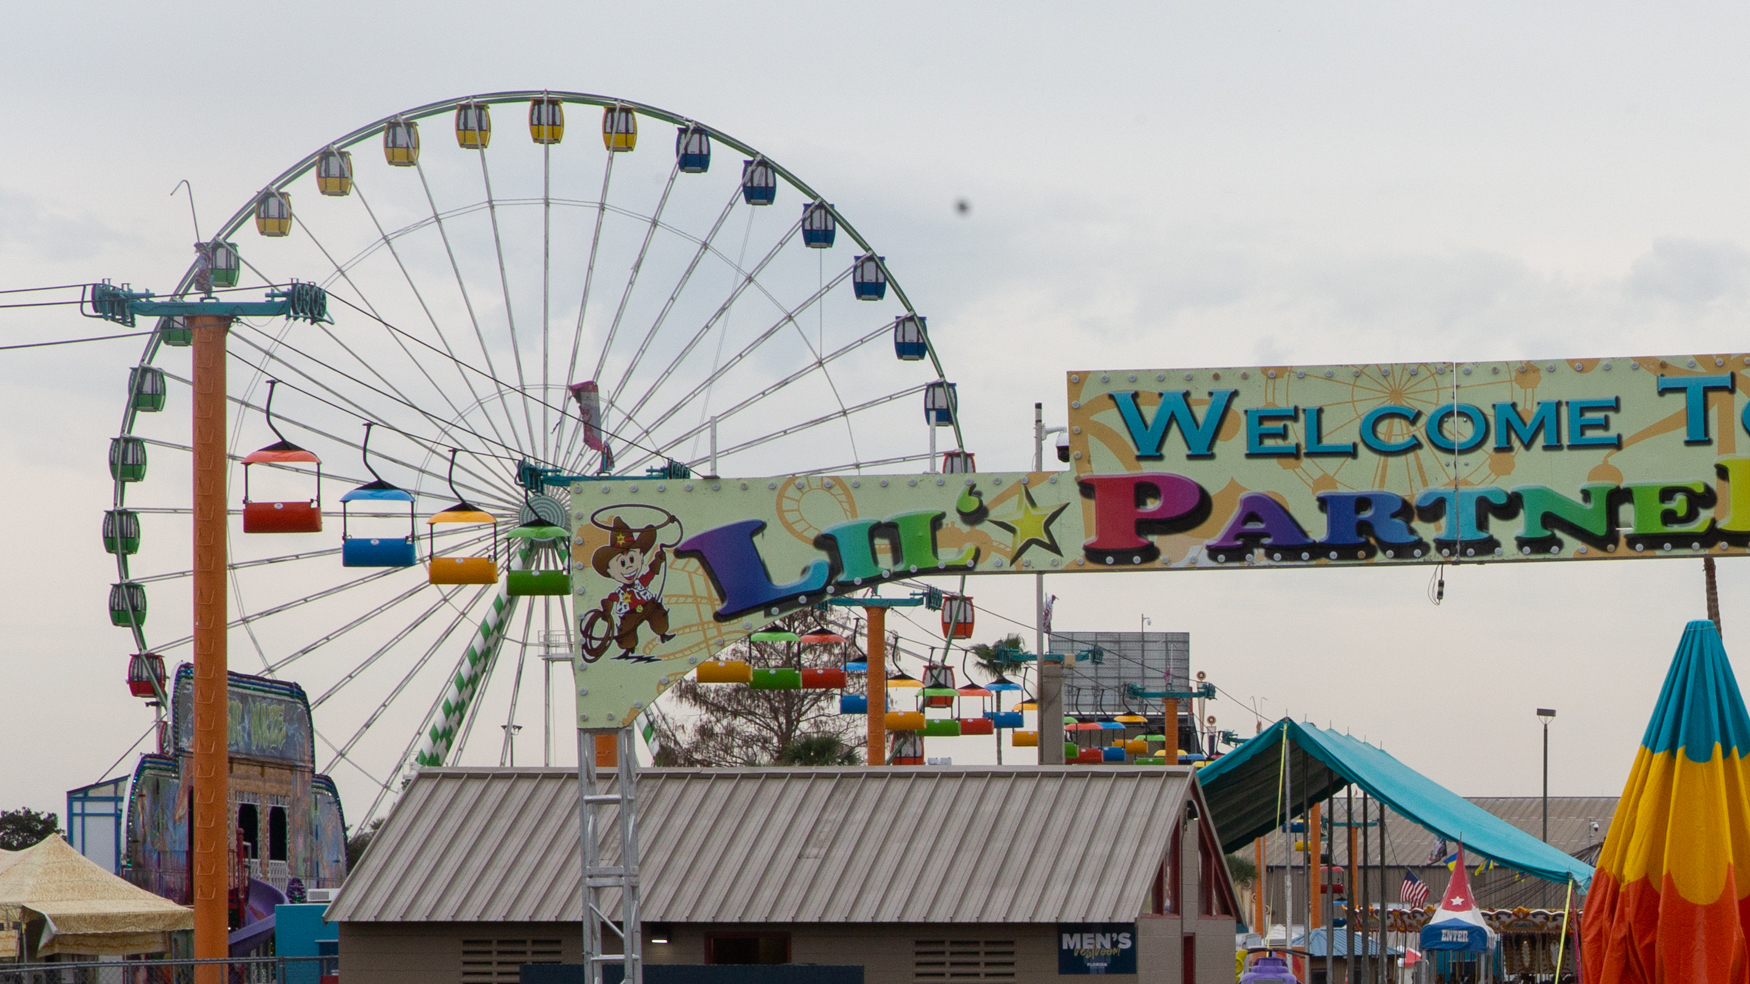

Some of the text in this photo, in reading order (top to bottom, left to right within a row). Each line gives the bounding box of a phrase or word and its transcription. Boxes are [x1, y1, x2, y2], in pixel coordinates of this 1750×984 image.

[1108, 389, 1621, 460] WELCOME
[1062, 932, 1132, 950] MEN'S
[1440, 929, 1469, 943] ENTER
